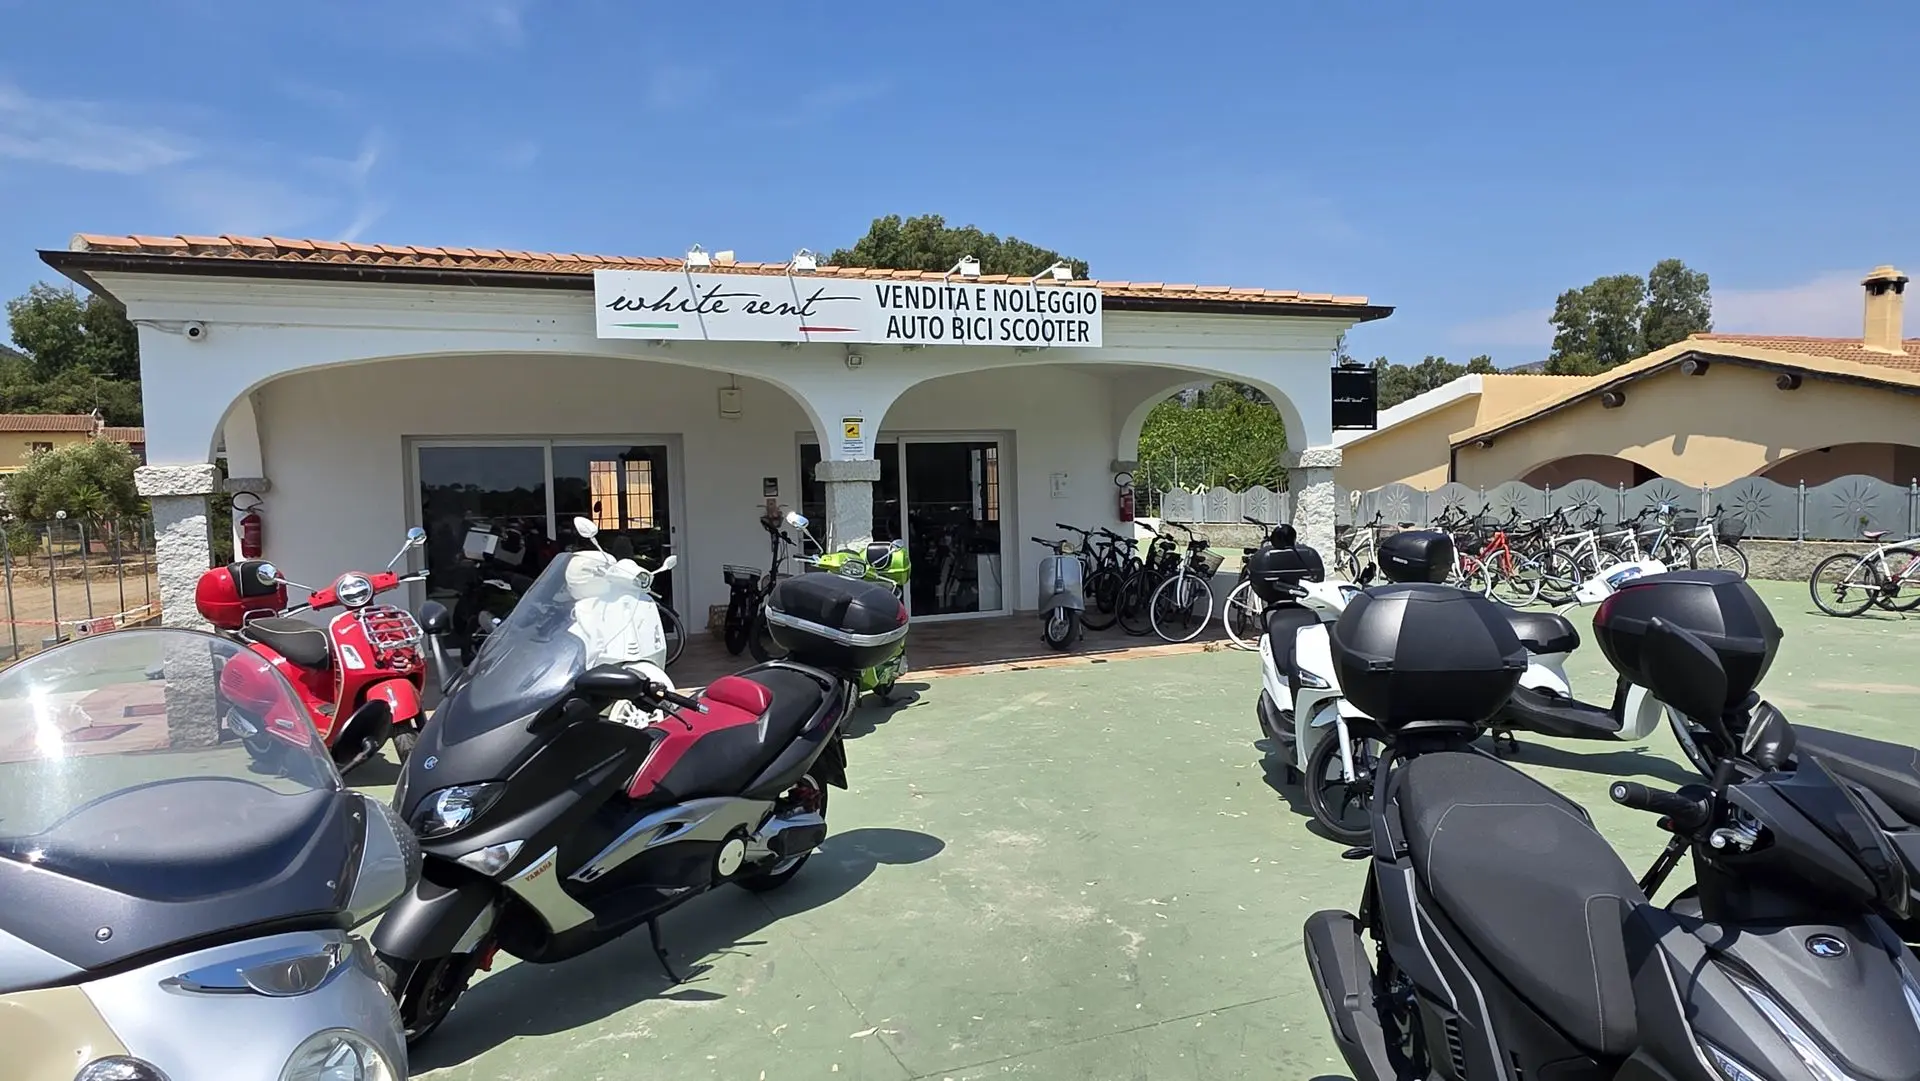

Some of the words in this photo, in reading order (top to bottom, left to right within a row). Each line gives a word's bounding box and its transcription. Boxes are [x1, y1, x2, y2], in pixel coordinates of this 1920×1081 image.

[606, 283, 761, 315] white
[742, 287, 862, 317] rent
[875, 284, 970, 311] VENDITA
[976, 288, 986, 312] E
[994, 289, 1097, 315] NOLEGGIO
[886, 315, 945, 340] AUTO
[952, 317, 993, 341] BICI
[1000, 318, 1090, 343] SCOOTER
